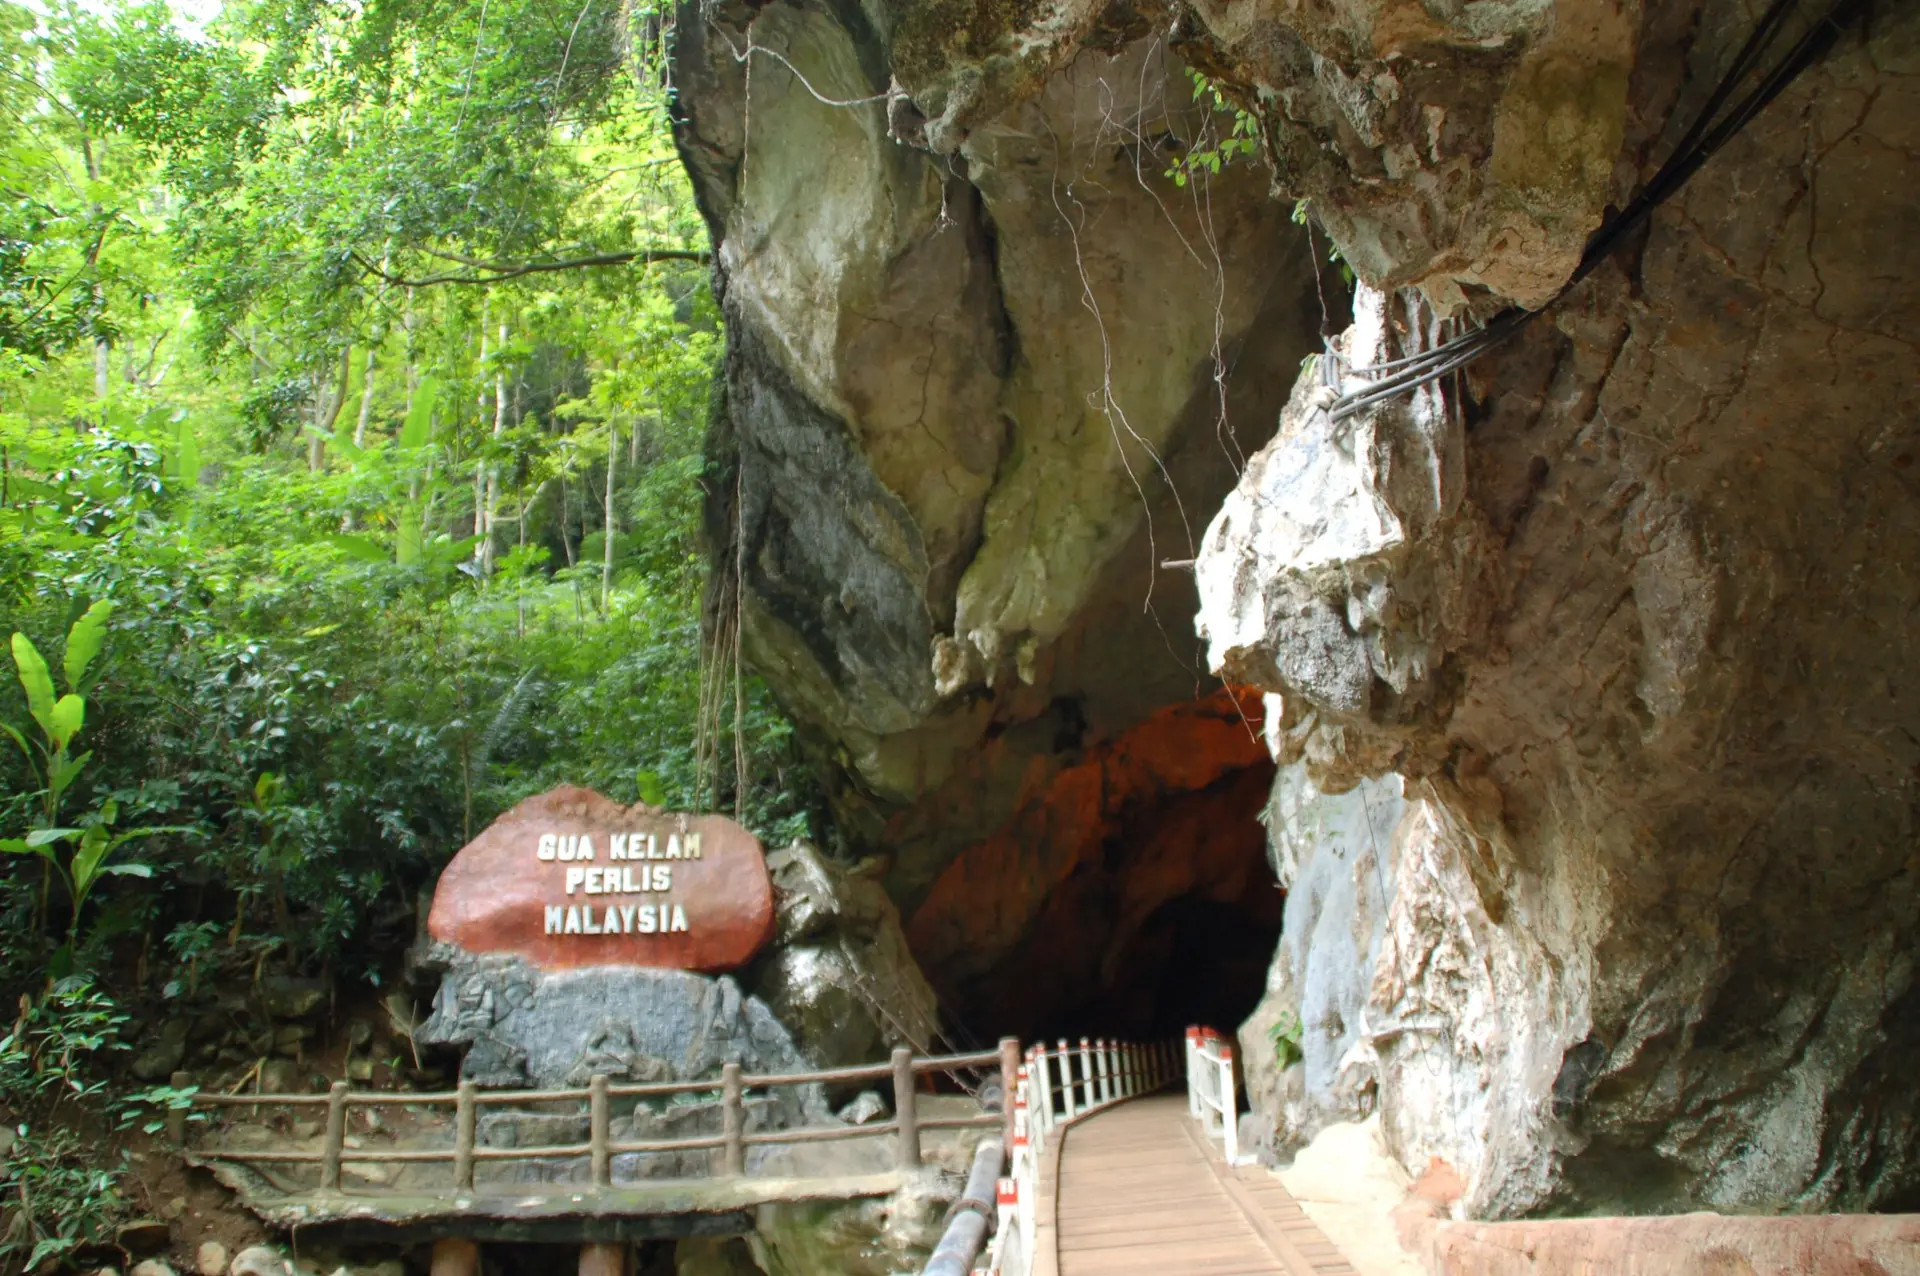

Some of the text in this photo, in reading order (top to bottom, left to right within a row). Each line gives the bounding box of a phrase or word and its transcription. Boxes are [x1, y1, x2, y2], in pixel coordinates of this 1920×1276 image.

[537, 832, 702, 861] GUA KELAM
[565, 865, 672, 895] PERLIS
[544, 903, 689, 935] MALAYSIA
